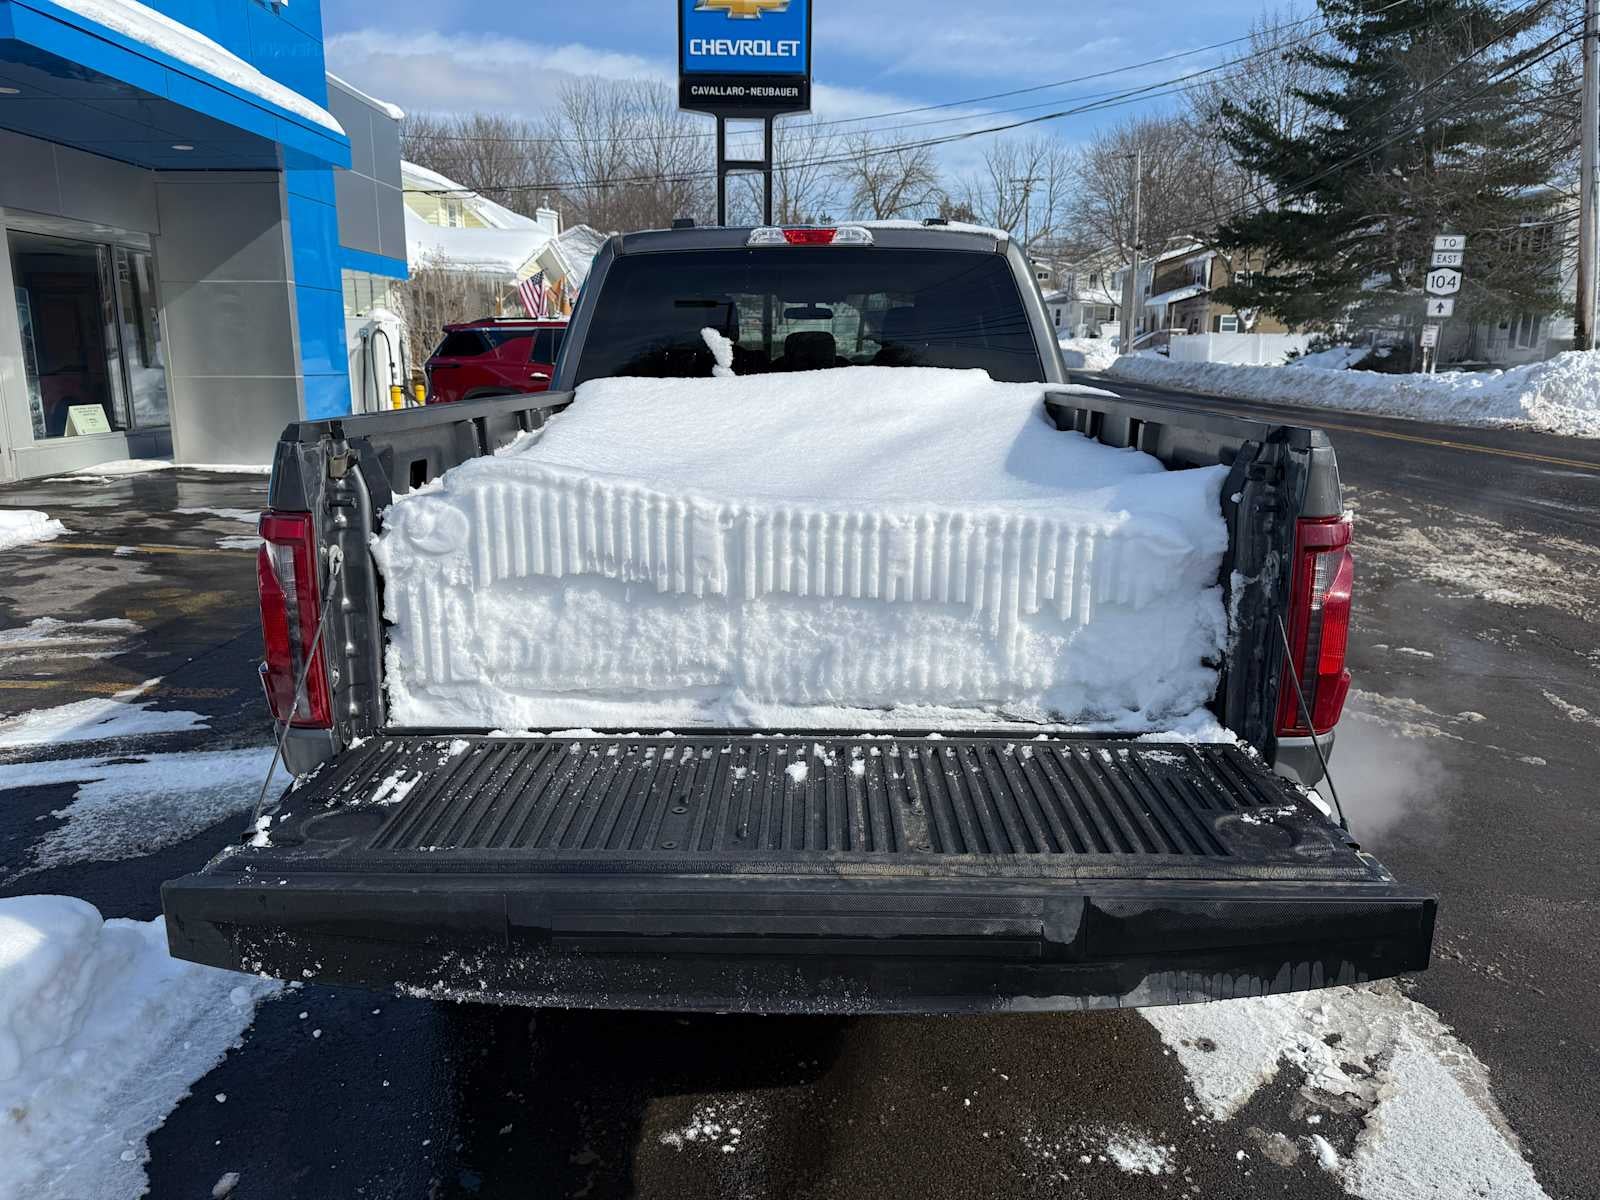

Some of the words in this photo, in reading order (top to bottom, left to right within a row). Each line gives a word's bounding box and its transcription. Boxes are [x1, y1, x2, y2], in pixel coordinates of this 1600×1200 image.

[689, 39, 800, 57] CHEVROLET
[691, 85, 798, 97] CAVALLARO-NEUBAUER
[1442, 238, 1457, 248] TO
[1436, 254, 1458, 264] EAST
[1430, 275, 1457, 289] 104
